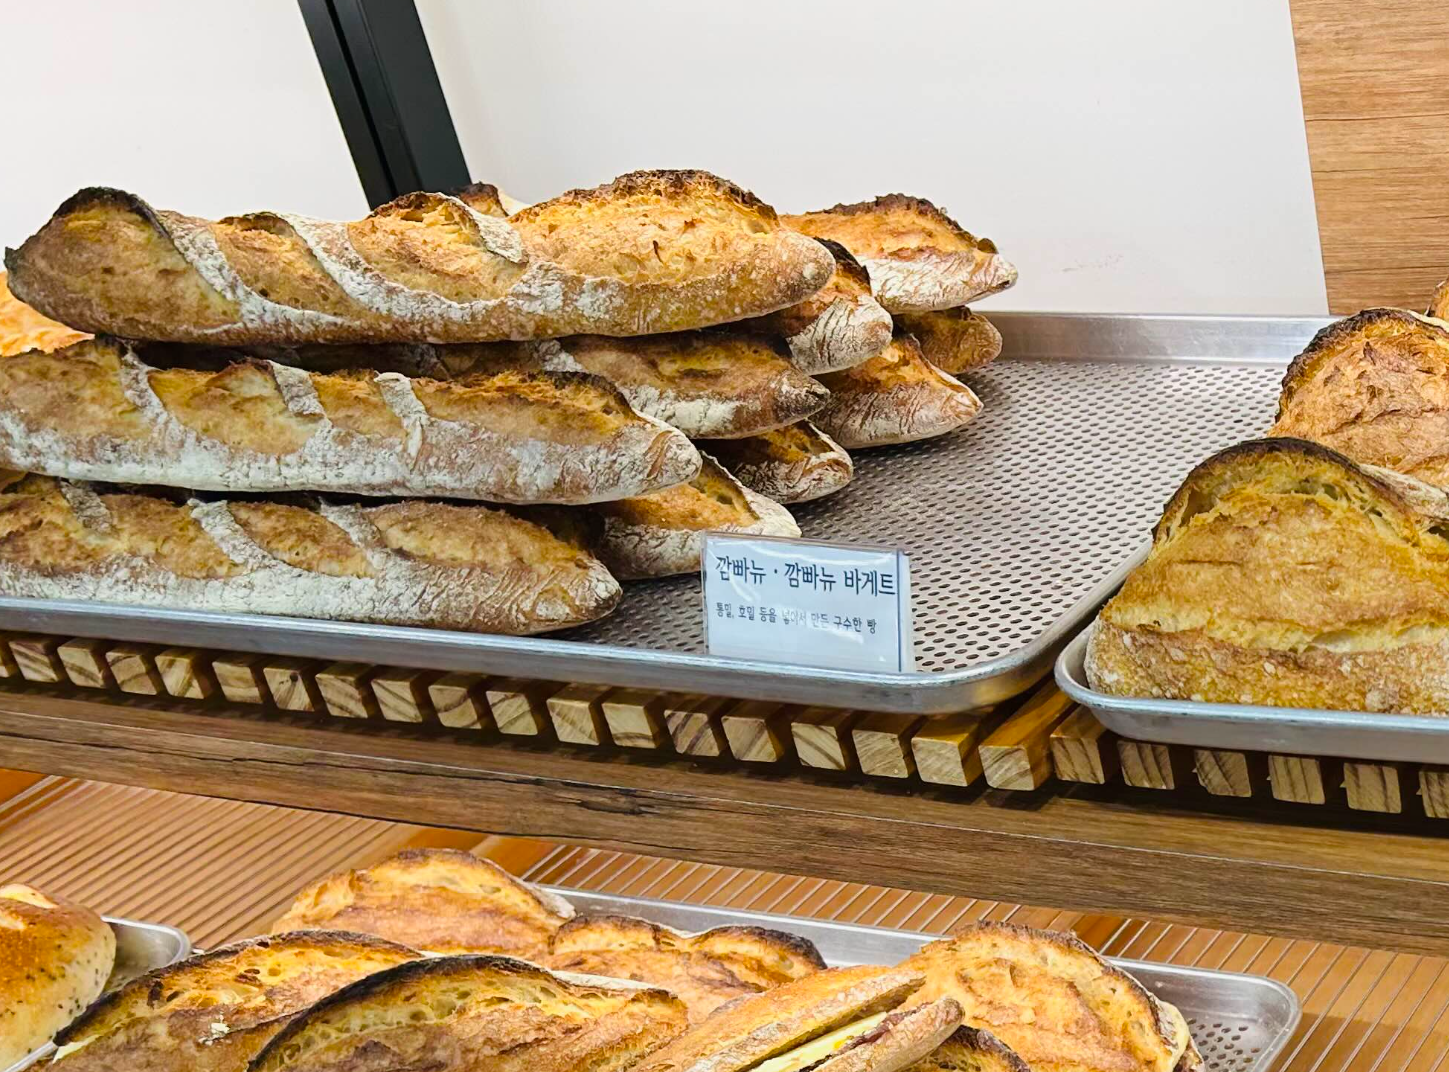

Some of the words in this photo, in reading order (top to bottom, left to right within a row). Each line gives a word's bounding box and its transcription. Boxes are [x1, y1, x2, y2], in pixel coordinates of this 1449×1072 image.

[715, 555, 767, 585] 깜빠뉴
[784, 562, 837, 593] 깜빠뉴
[843, 568, 896, 597] 바게트
[738, 605, 755, 621] 호밀
[758, 606, 777, 624] 등을
[833, 615, 862, 633] 구수한
[866, 618, 877, 635] 빵
